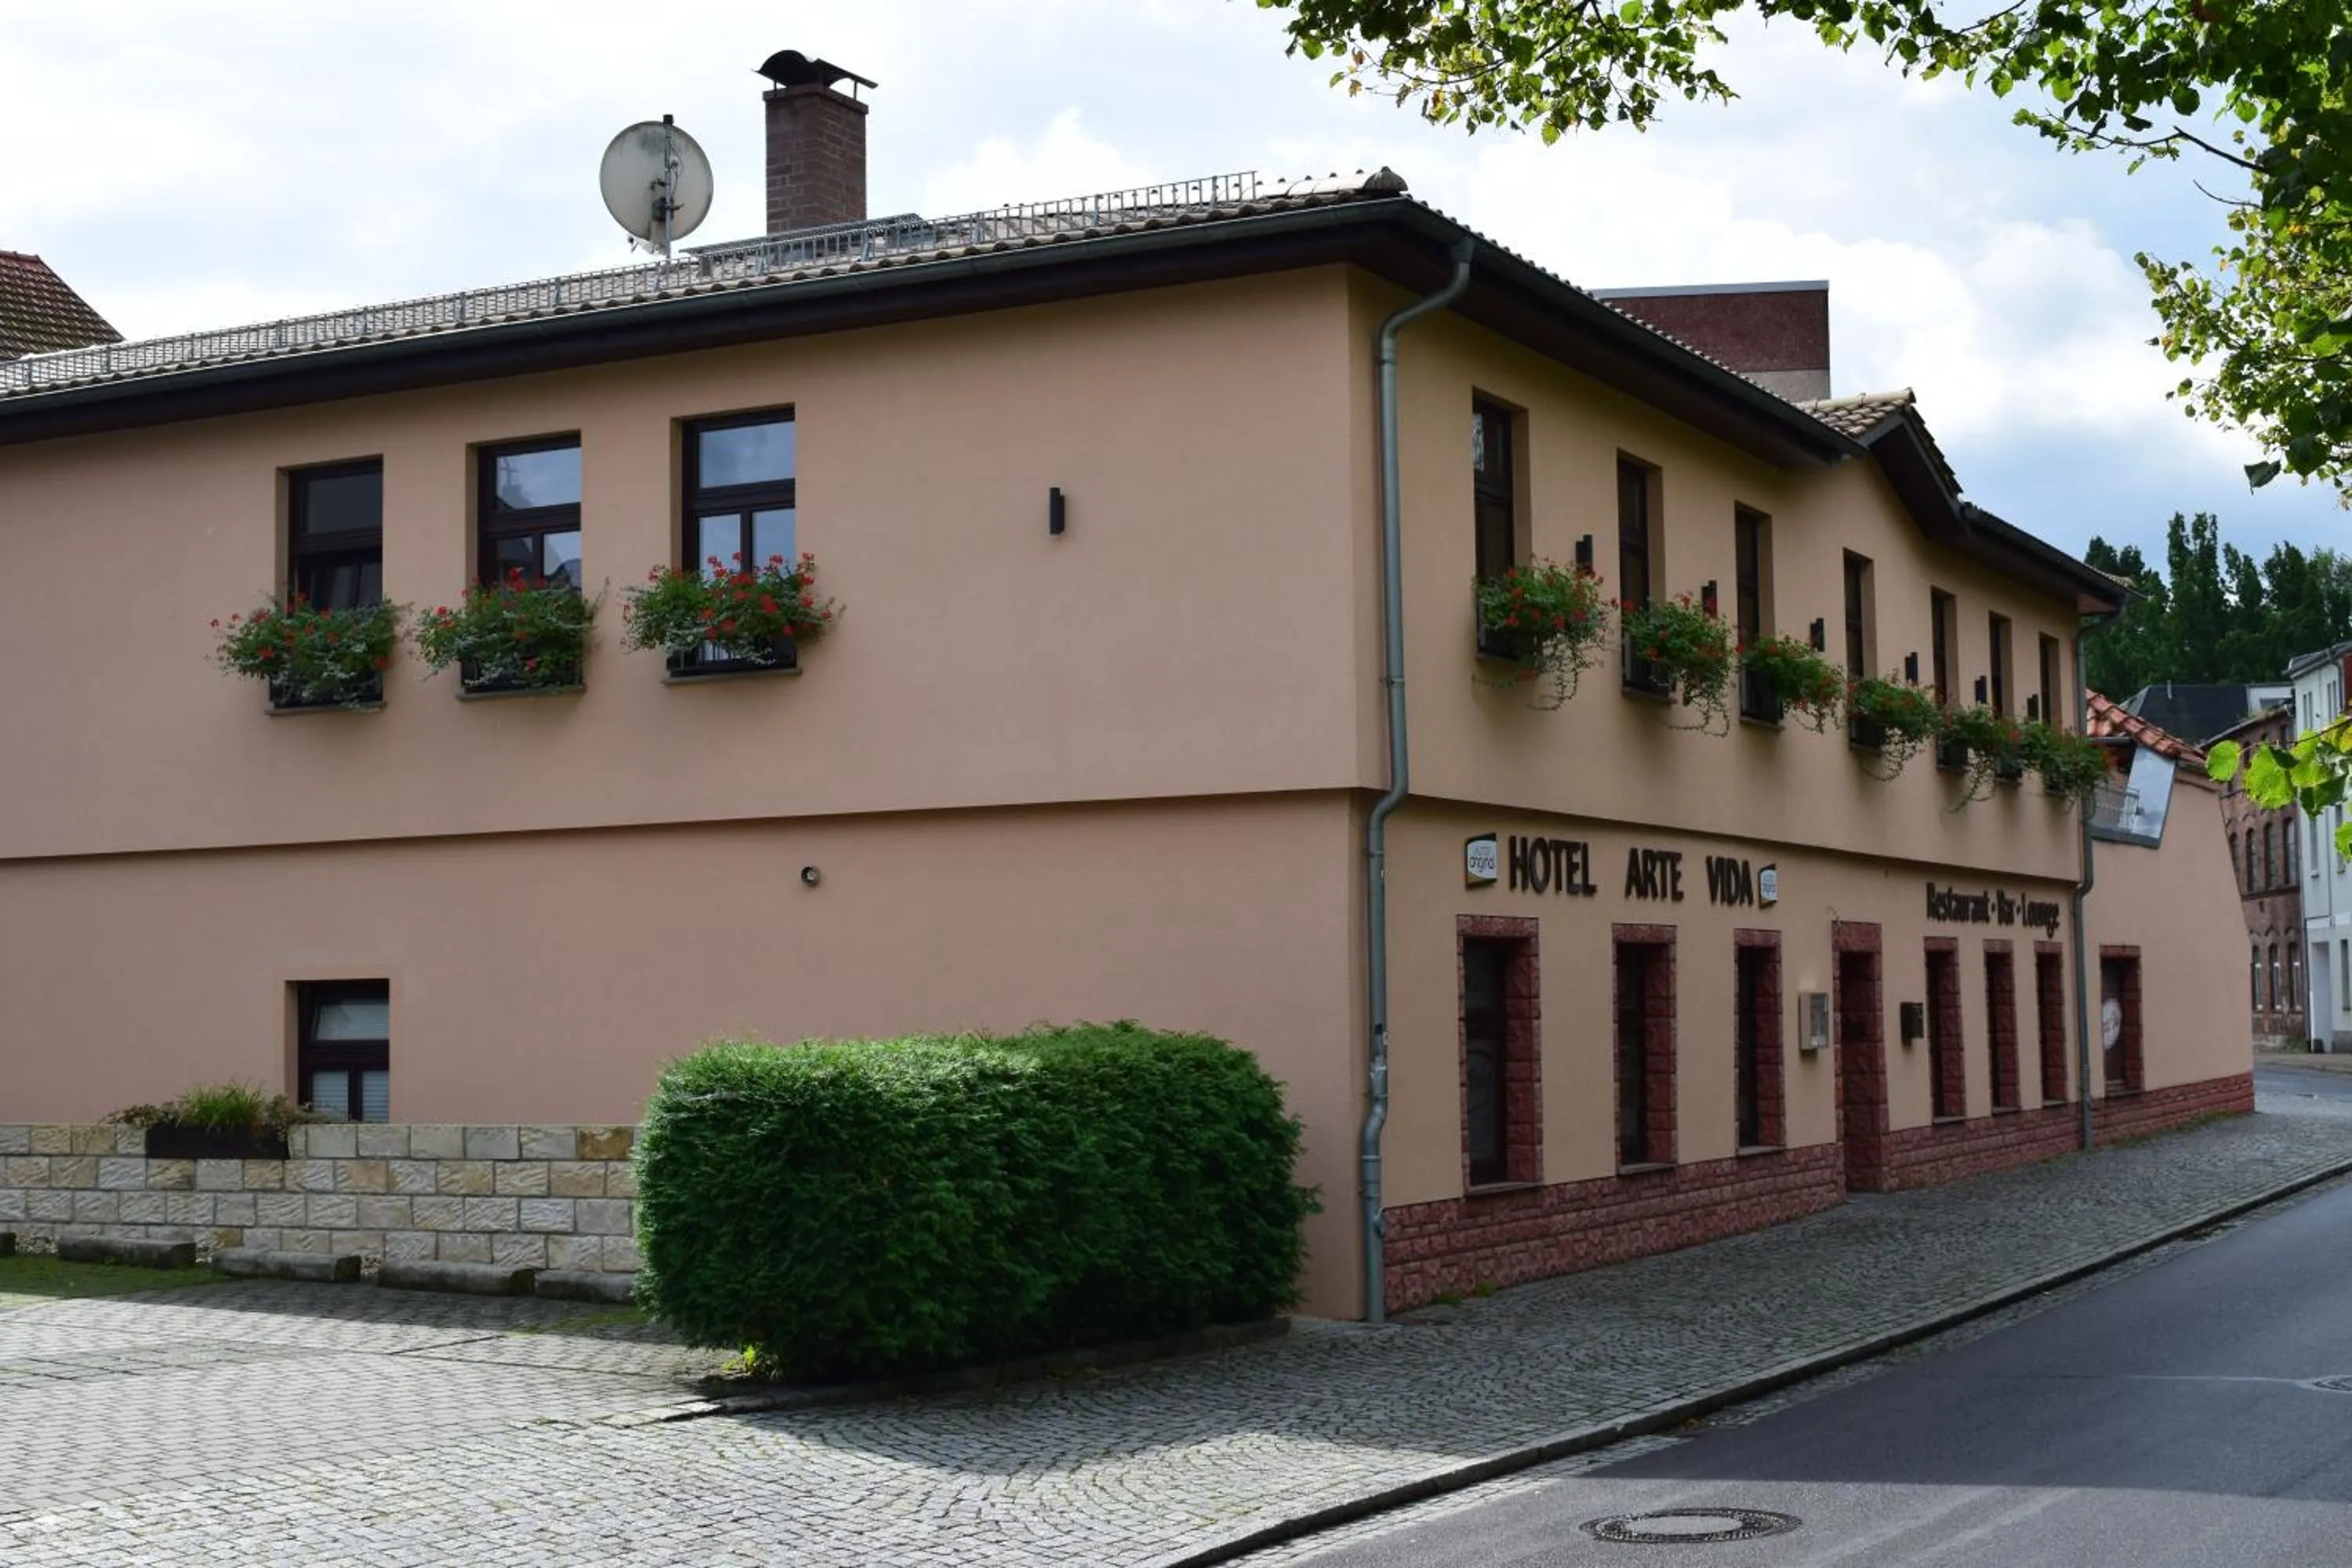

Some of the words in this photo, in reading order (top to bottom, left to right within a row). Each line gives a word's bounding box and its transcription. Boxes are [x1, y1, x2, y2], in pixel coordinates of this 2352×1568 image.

[1508, 835, 1598, 898] HOTEL
[1624, 848, 1684, 902] ARTE
[1706, 855, 1754, 906] VIDA
